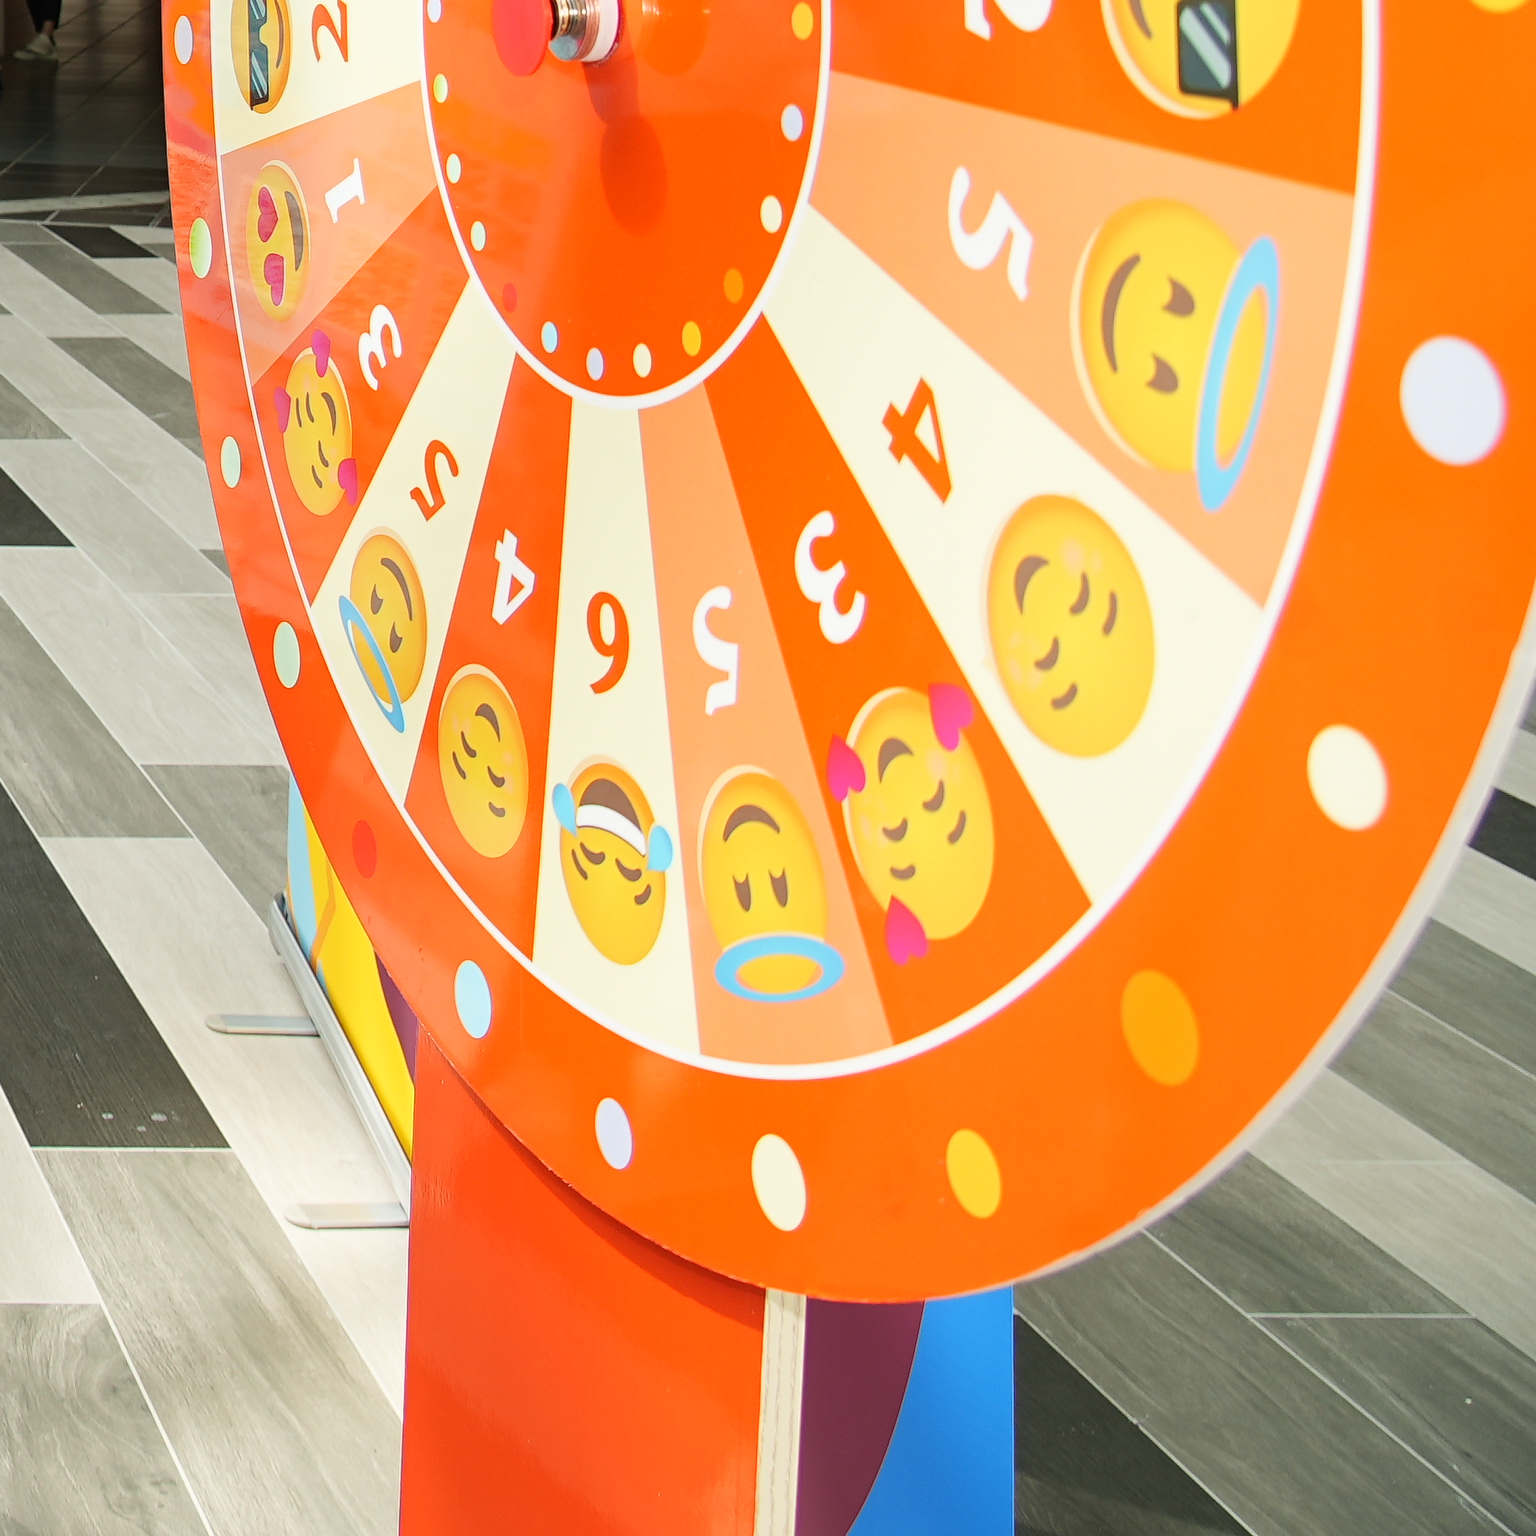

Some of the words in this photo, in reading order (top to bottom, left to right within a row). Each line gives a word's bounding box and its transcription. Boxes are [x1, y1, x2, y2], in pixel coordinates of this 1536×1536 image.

[325, 158, 366, 223] 1
[949, 167, 1034, 301] 5
[359, 305, 403, 390] 3
[410, 440, 459, 521] 5
[883, 379, 952, 503] 4
[492, 529, 536, 625] 4
[795, 511, 867, 644] 3
[693, 586, 740, 716] 5
